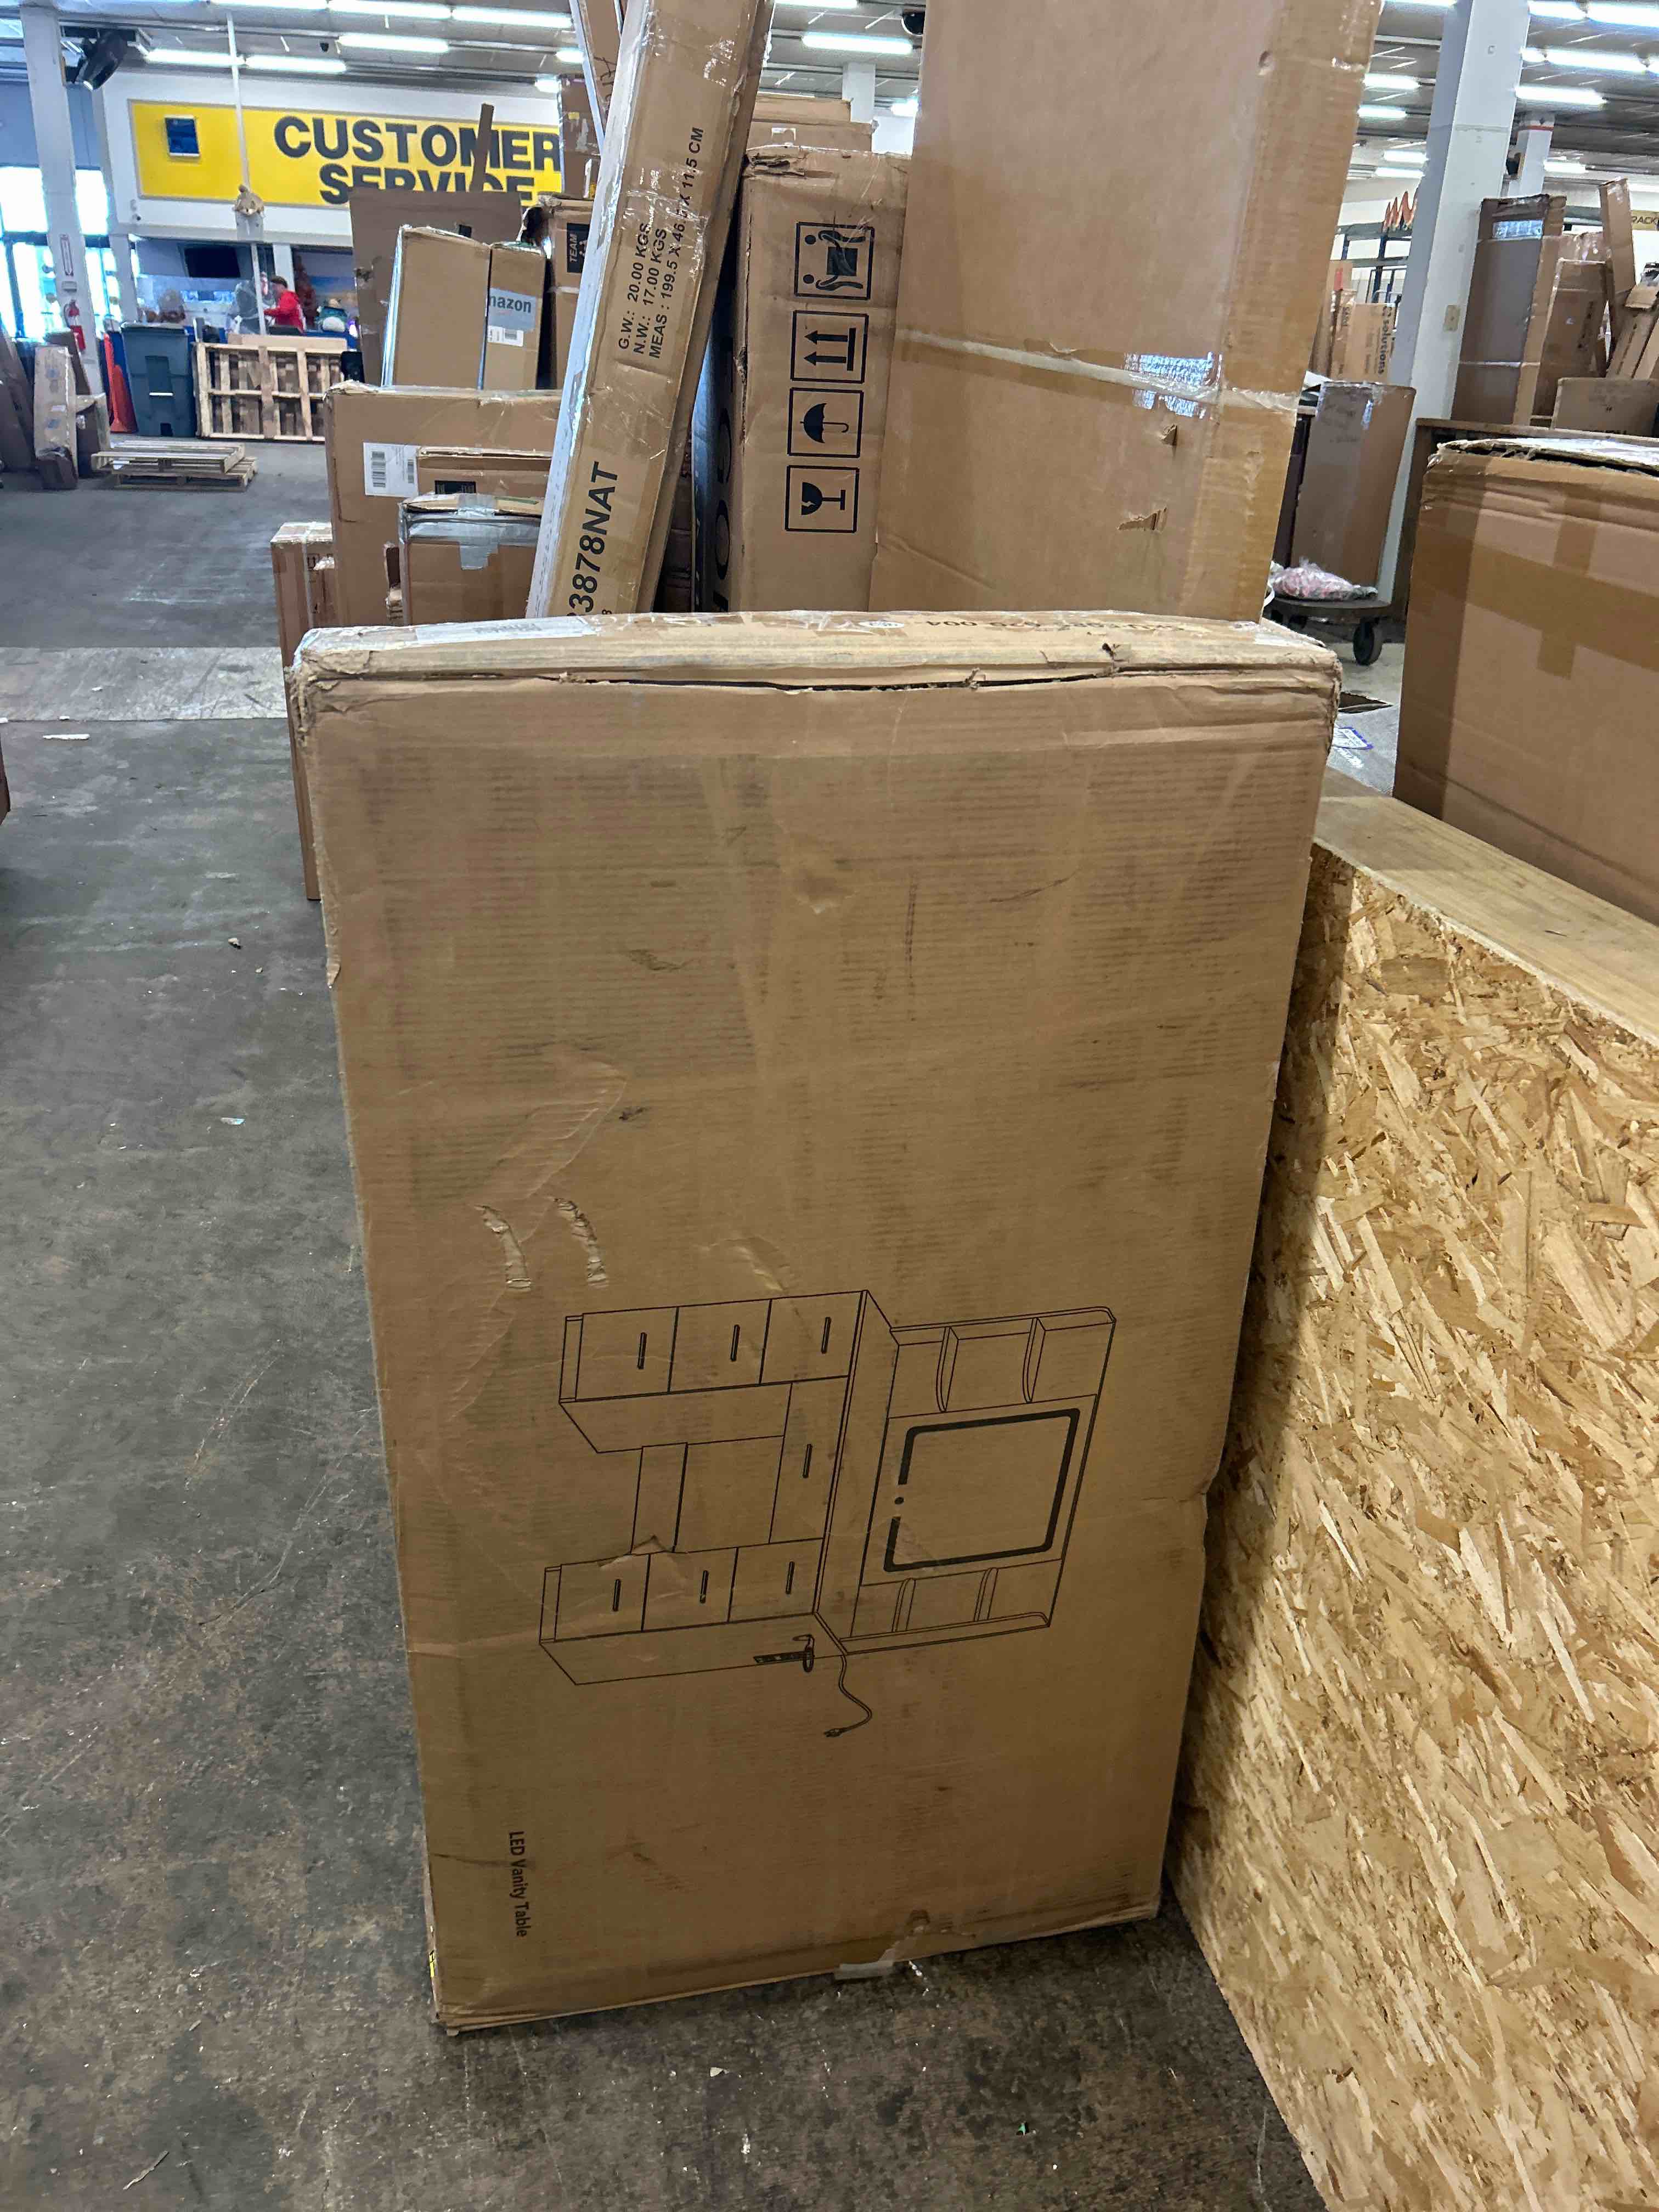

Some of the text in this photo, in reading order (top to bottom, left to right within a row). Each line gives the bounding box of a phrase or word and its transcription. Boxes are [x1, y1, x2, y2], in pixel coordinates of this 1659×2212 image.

[274, 115, 561, 172] CUSTOMER
[689, 127, 704, 154] CM
[682, 157, 698, 188] 11.5
[680, 194, 691, 206] X
[569, 233, 578, 263] TEAM
[619, 223, 651, 349] G.W.: 20.00 KGS
[633, 228, 667, 354] N.W.: 17.00 KGS
[661, 260, 678, 299] 199.5
[649, 314, 667, 359] MEAS
[567, 461, 618, 616] 3878NAT
[509, 1831, 532, 1938] LED Vanity Table
